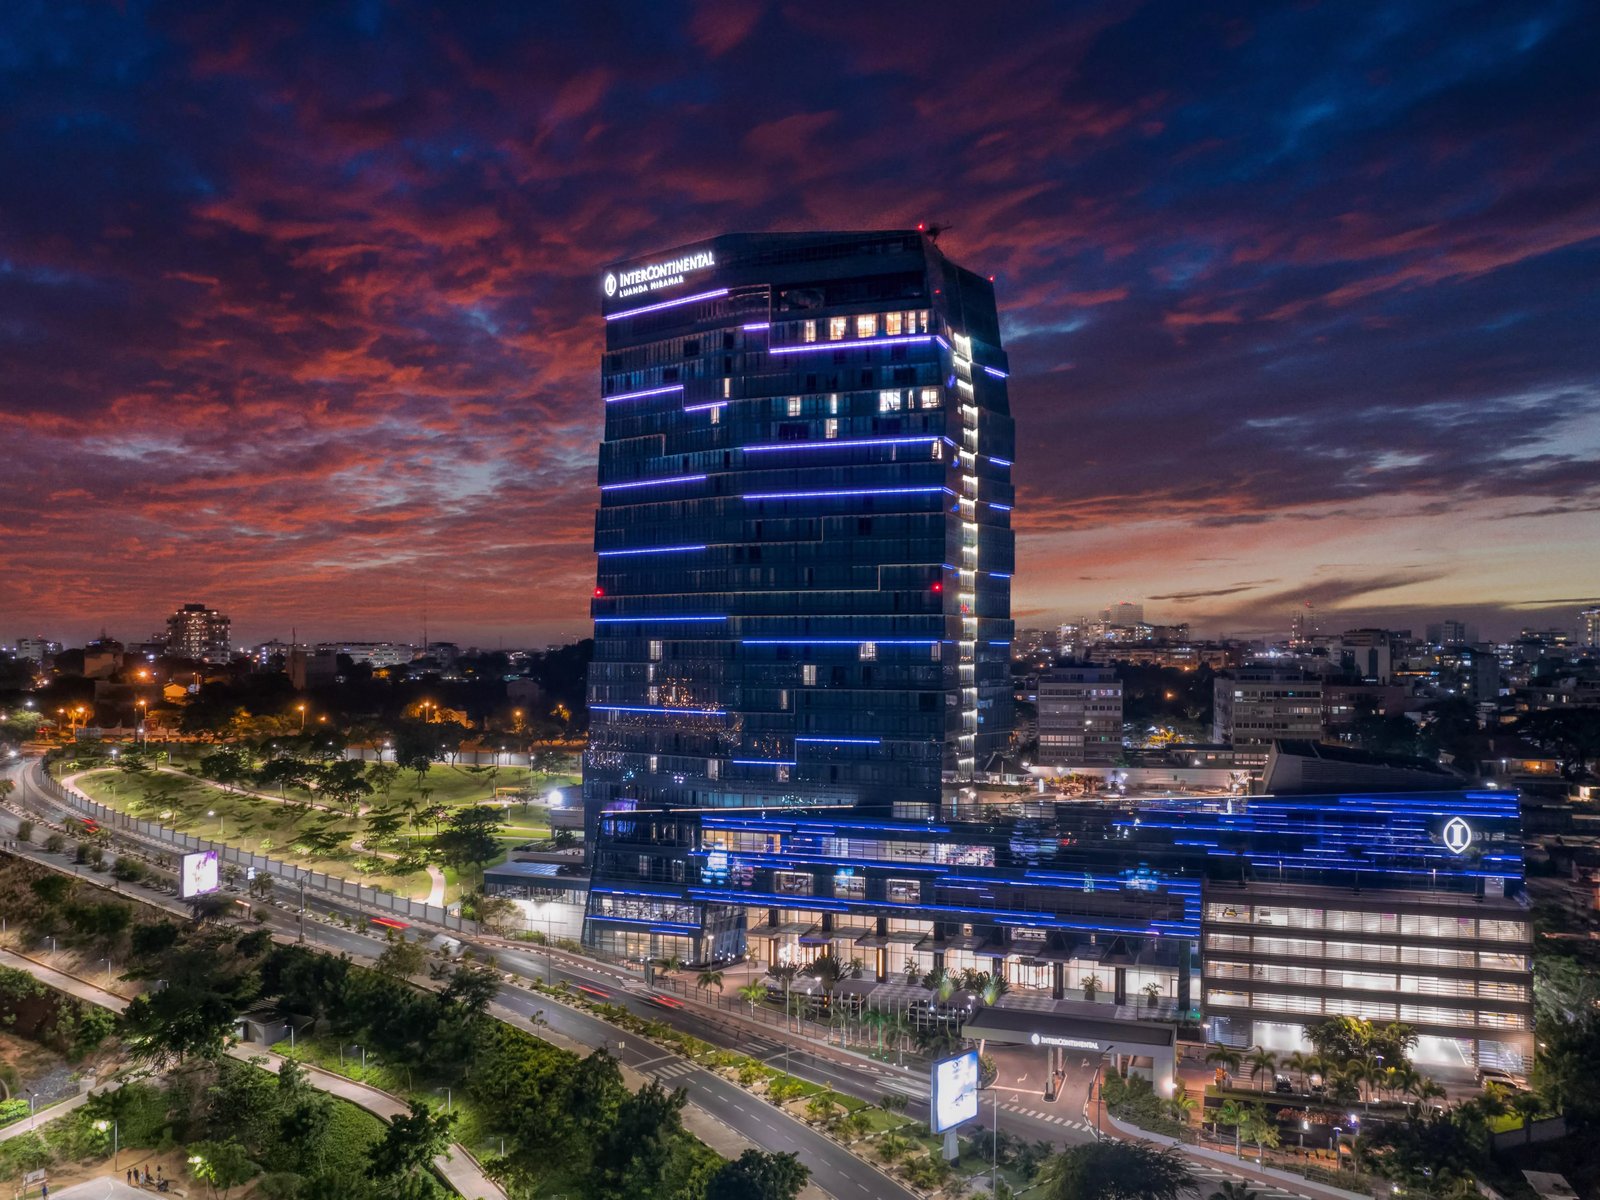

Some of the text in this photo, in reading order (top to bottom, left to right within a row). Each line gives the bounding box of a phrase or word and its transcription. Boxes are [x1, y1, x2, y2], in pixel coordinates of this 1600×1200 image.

[620, 251, 715, 287] INTERCONTINENTAL
[619, 275, 684, 298] LUANDA MIRAMAR
